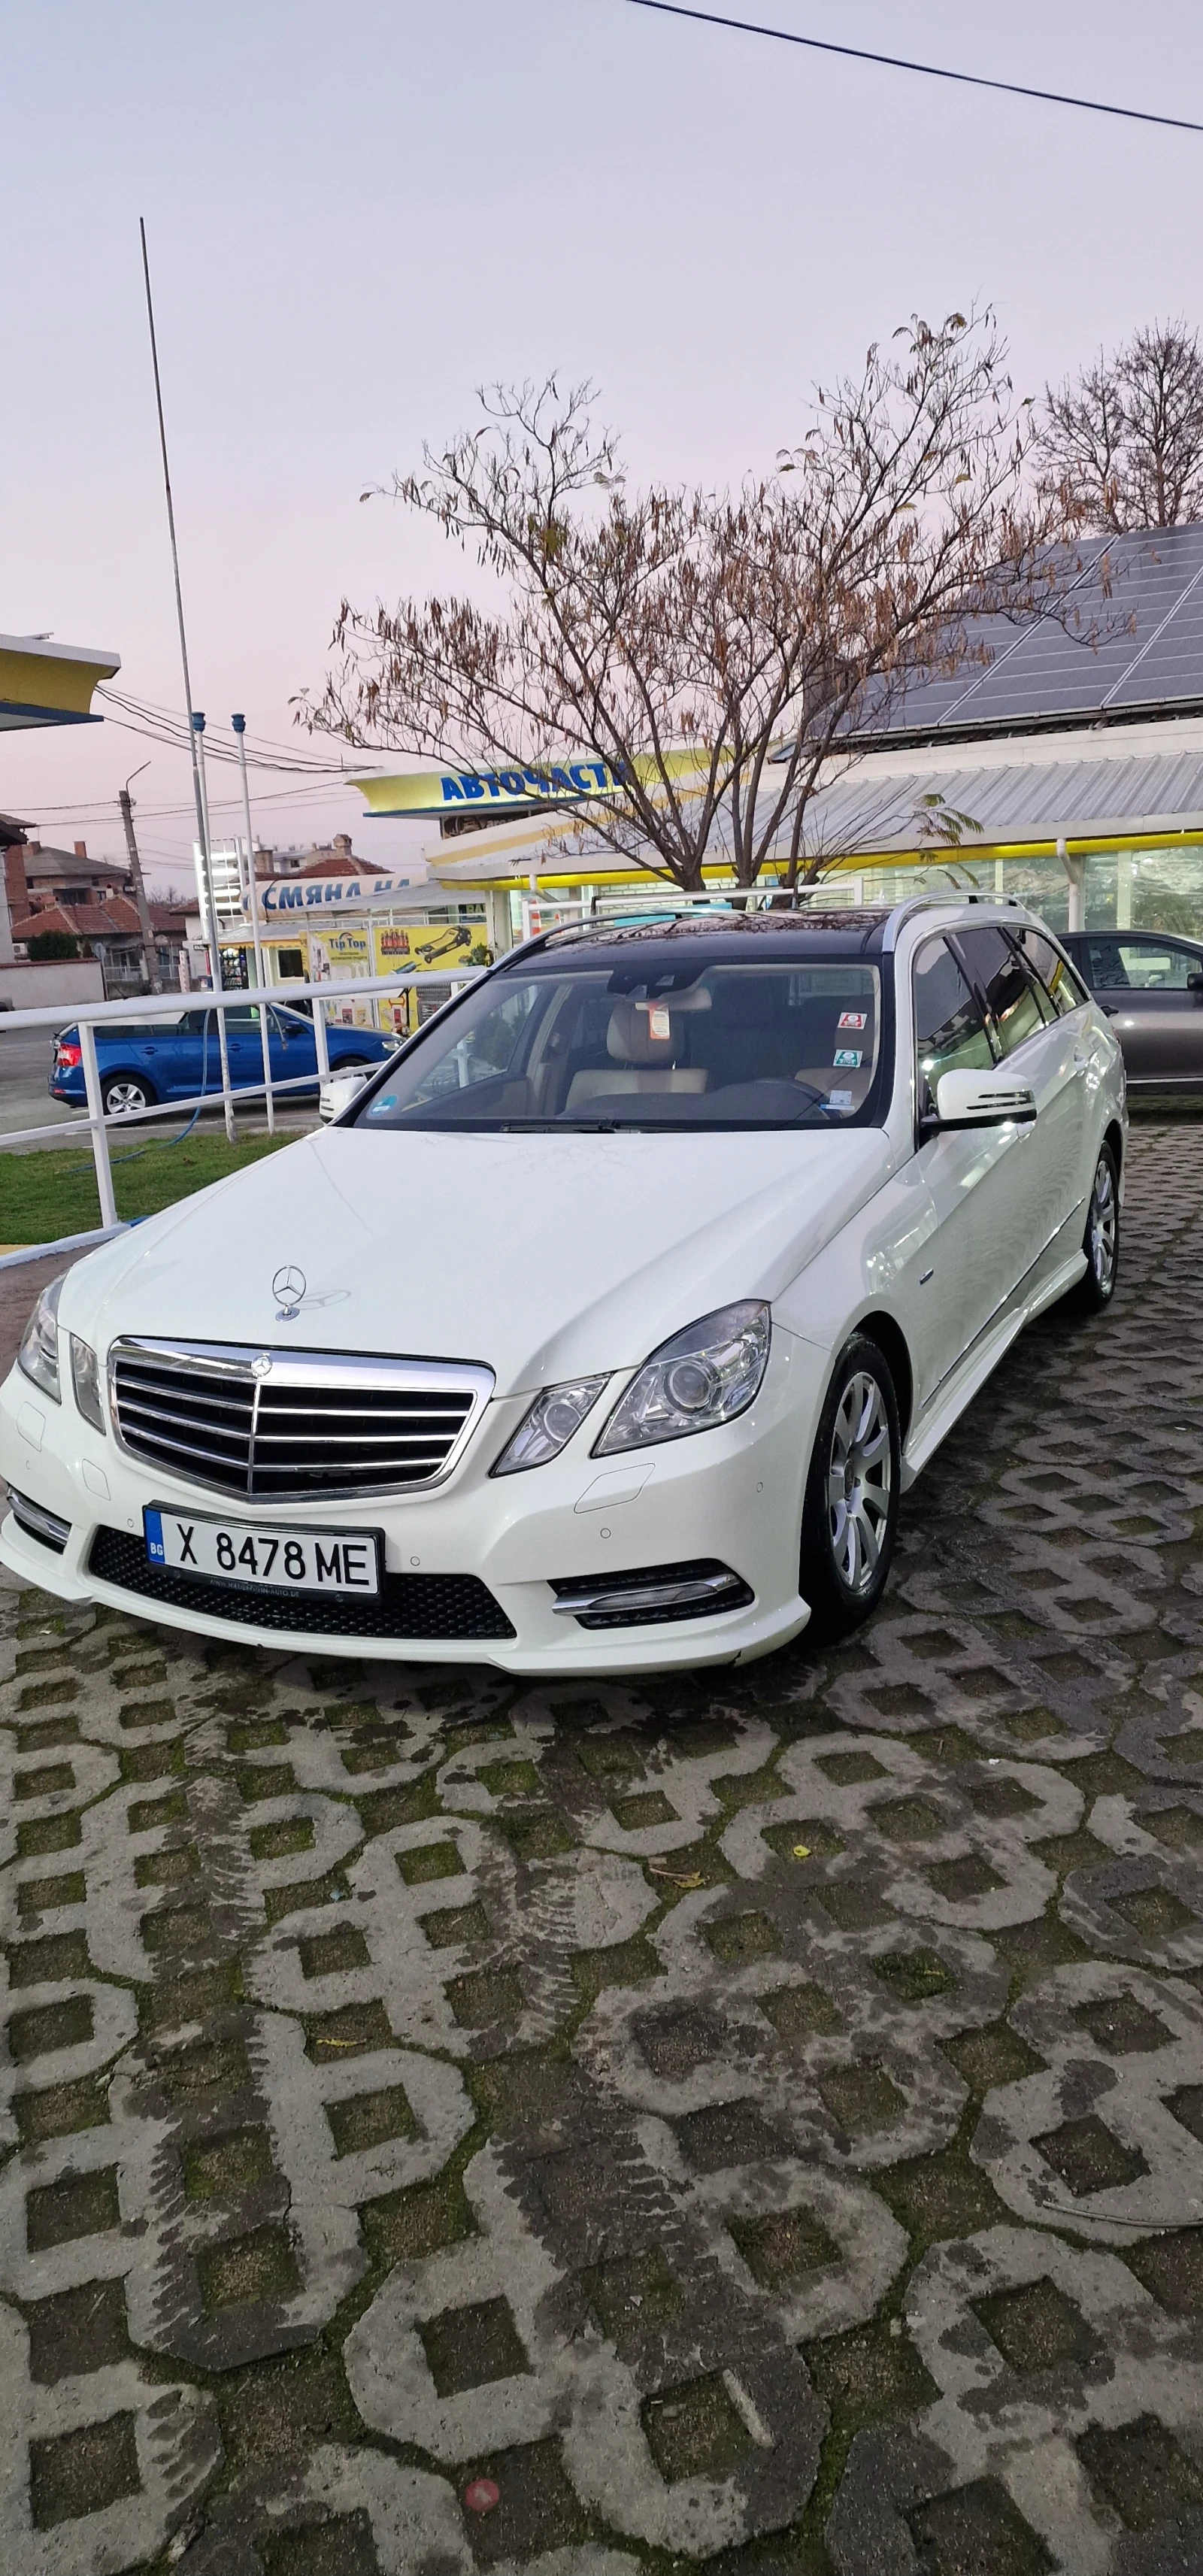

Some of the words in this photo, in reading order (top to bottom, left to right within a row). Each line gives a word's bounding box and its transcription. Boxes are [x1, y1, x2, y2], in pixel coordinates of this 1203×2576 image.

[329, 938, 345, 951] Tip
[347, 938, 366, 951] Top
[150, 1542, 163, 1556] BG
[177, 1523, 198, 1565] X
[216, 1532, 306, 1580] 8478
[314, 1542, 369, 1586] ME
